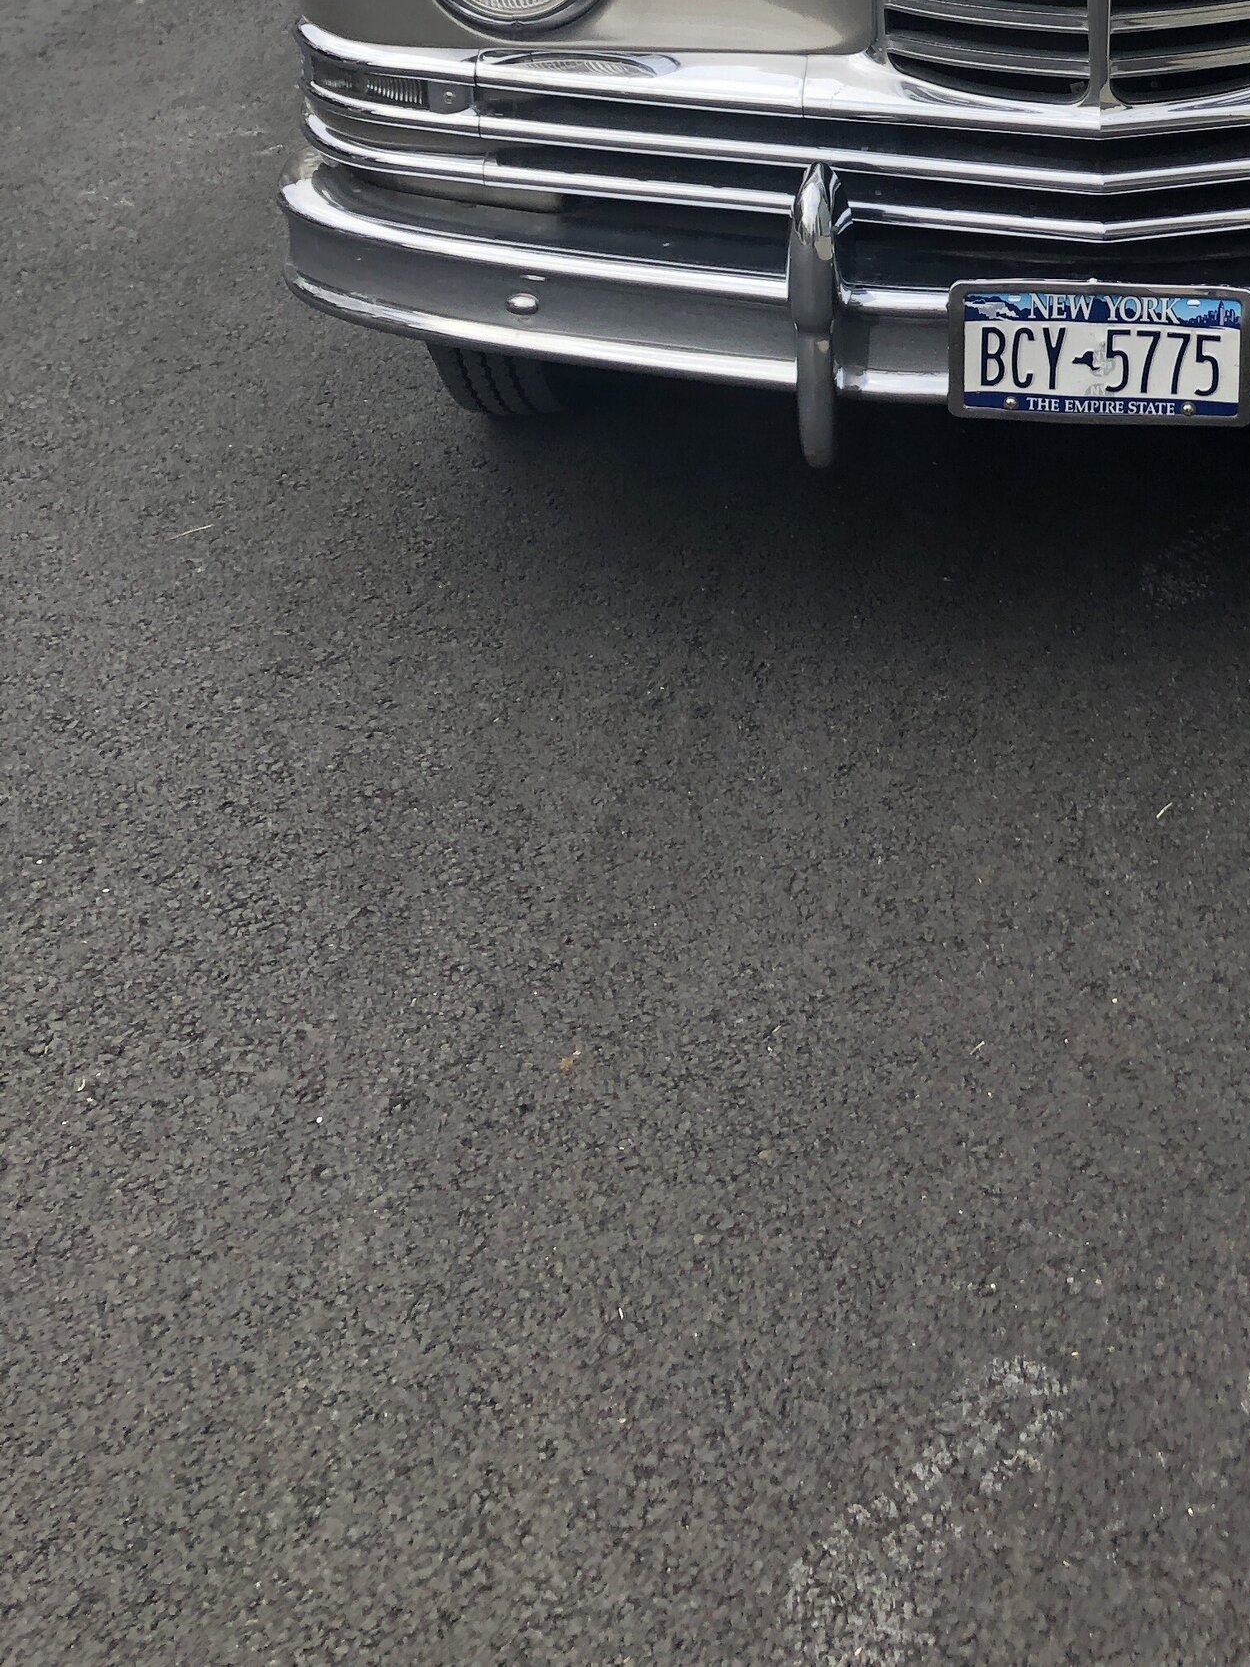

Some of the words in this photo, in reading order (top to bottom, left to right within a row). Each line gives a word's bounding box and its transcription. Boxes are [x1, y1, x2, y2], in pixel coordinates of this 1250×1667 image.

[1028, 293, 1095, 321] NEW
[1104, 295, 1181, 325] YORK
[980, 326, 1066, 390] BCY
[1105, 329, 1221, 396] 5775
[1026, 396, 1060, 412] THE
[1064, 399, 1125, 415] EMPIRE
[1127, 401, 1176, 415] STATE
